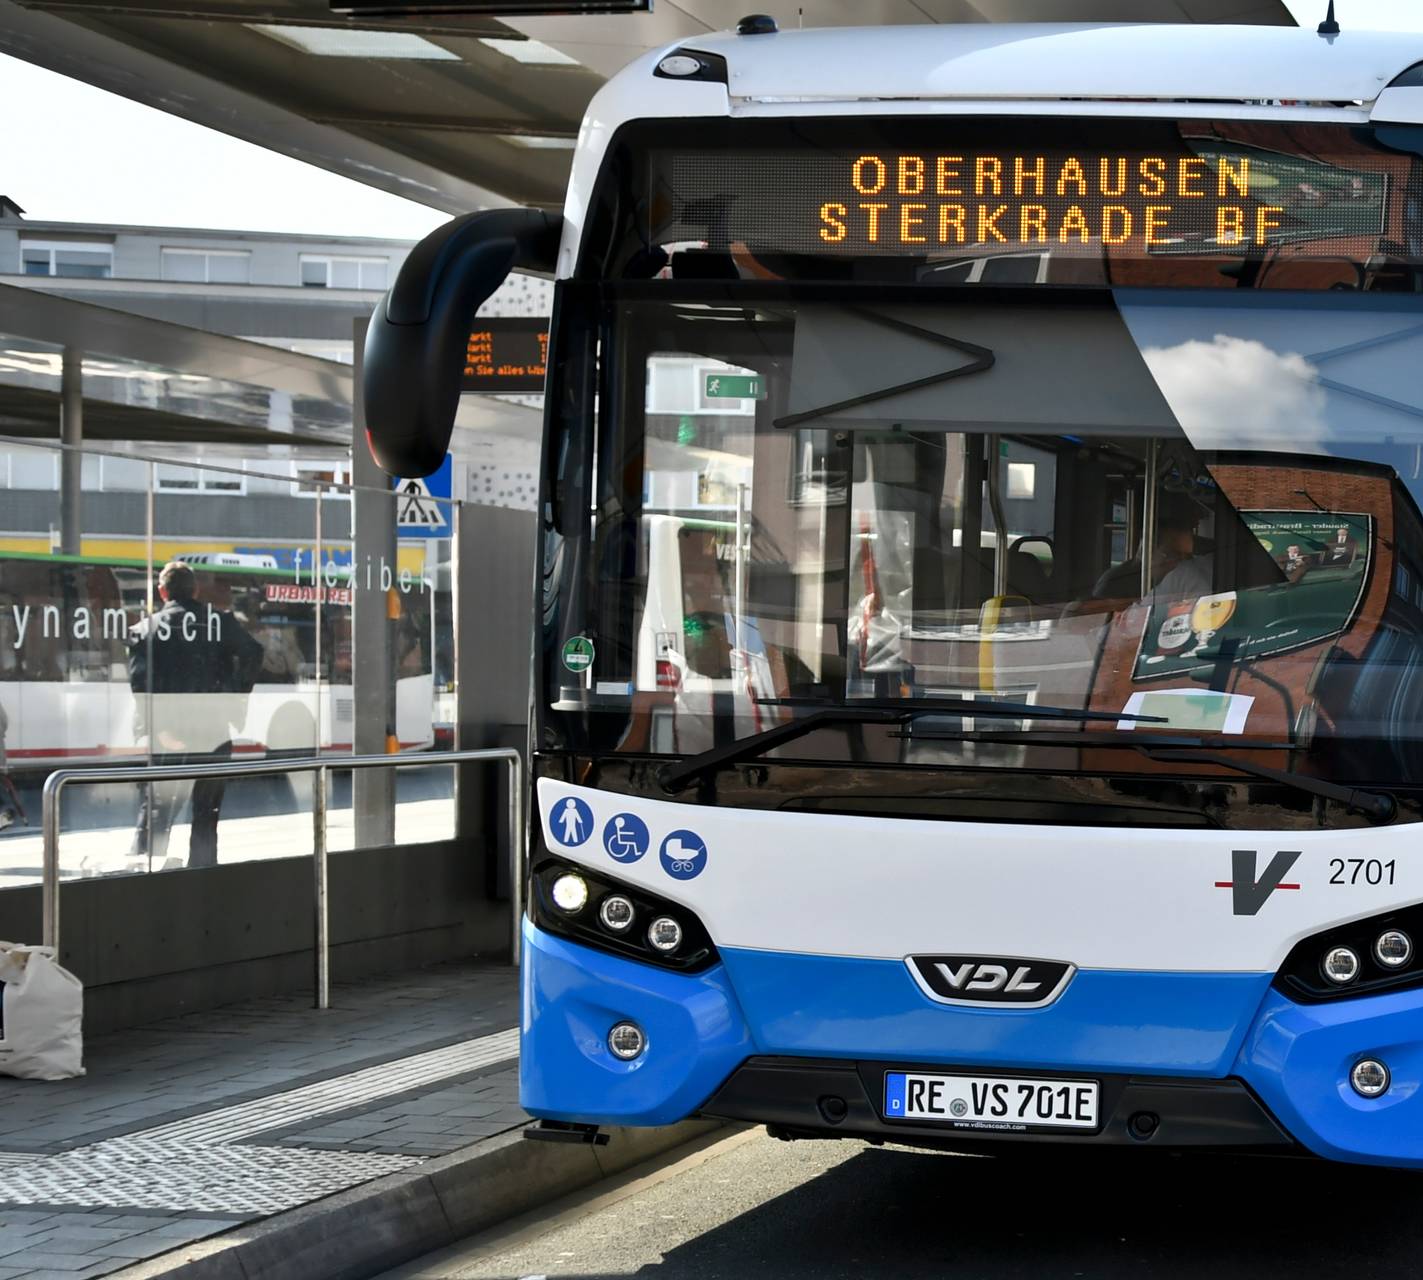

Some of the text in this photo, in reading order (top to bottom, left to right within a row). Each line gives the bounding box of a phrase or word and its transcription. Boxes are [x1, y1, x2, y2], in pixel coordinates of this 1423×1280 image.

[852, 156, 1249, 197] OBERHAUSEN
[820, 203, 1284, 245] STERKRADE BF
[294, 548, 425, 595] flexibel
[1329, 858, 1396, 885] 2701
[933, 962, 1043, 993] VDL
[907, 1078, 946, 1114] RE
[971, 1082, 1009, 1118] VS
[1017, 1085, 1094, 1122] 701E
[953, 1121, 1028, 1131] www.vdlbuscoach.com
